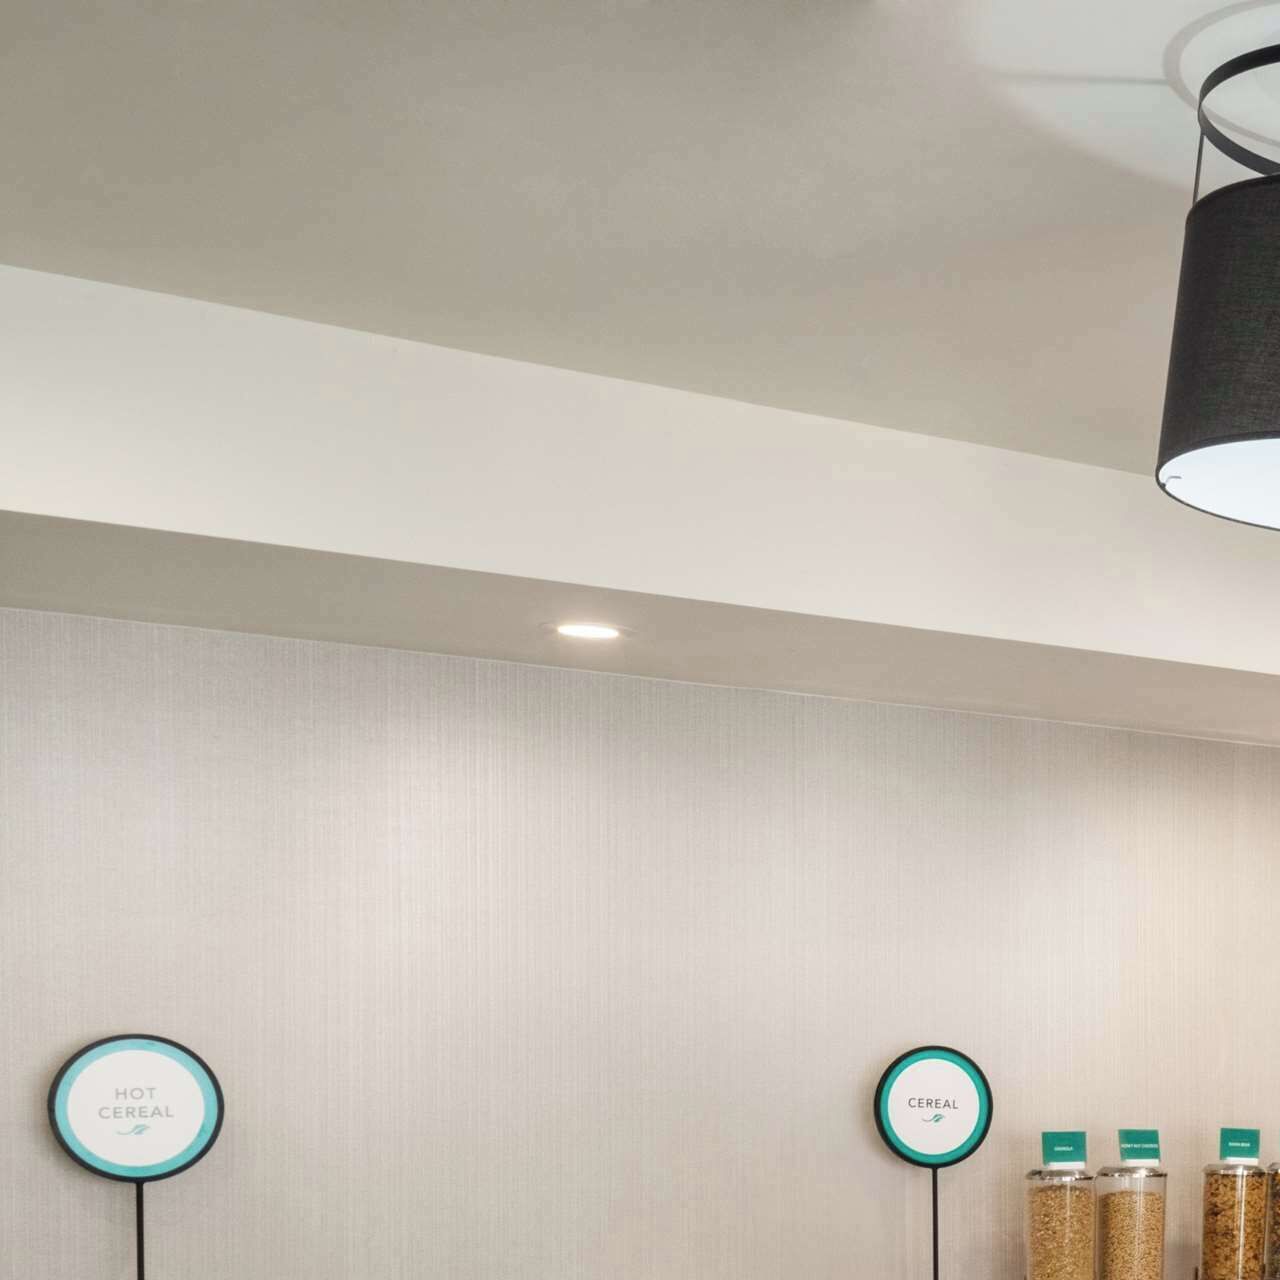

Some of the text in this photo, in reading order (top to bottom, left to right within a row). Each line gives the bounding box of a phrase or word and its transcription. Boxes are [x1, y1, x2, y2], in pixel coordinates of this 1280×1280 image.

[115, 1087, 156, 1100] HOT
[908, 1097, 959, 1109] CEREAL
[98, 1105, 174, 1119] CEREAL
